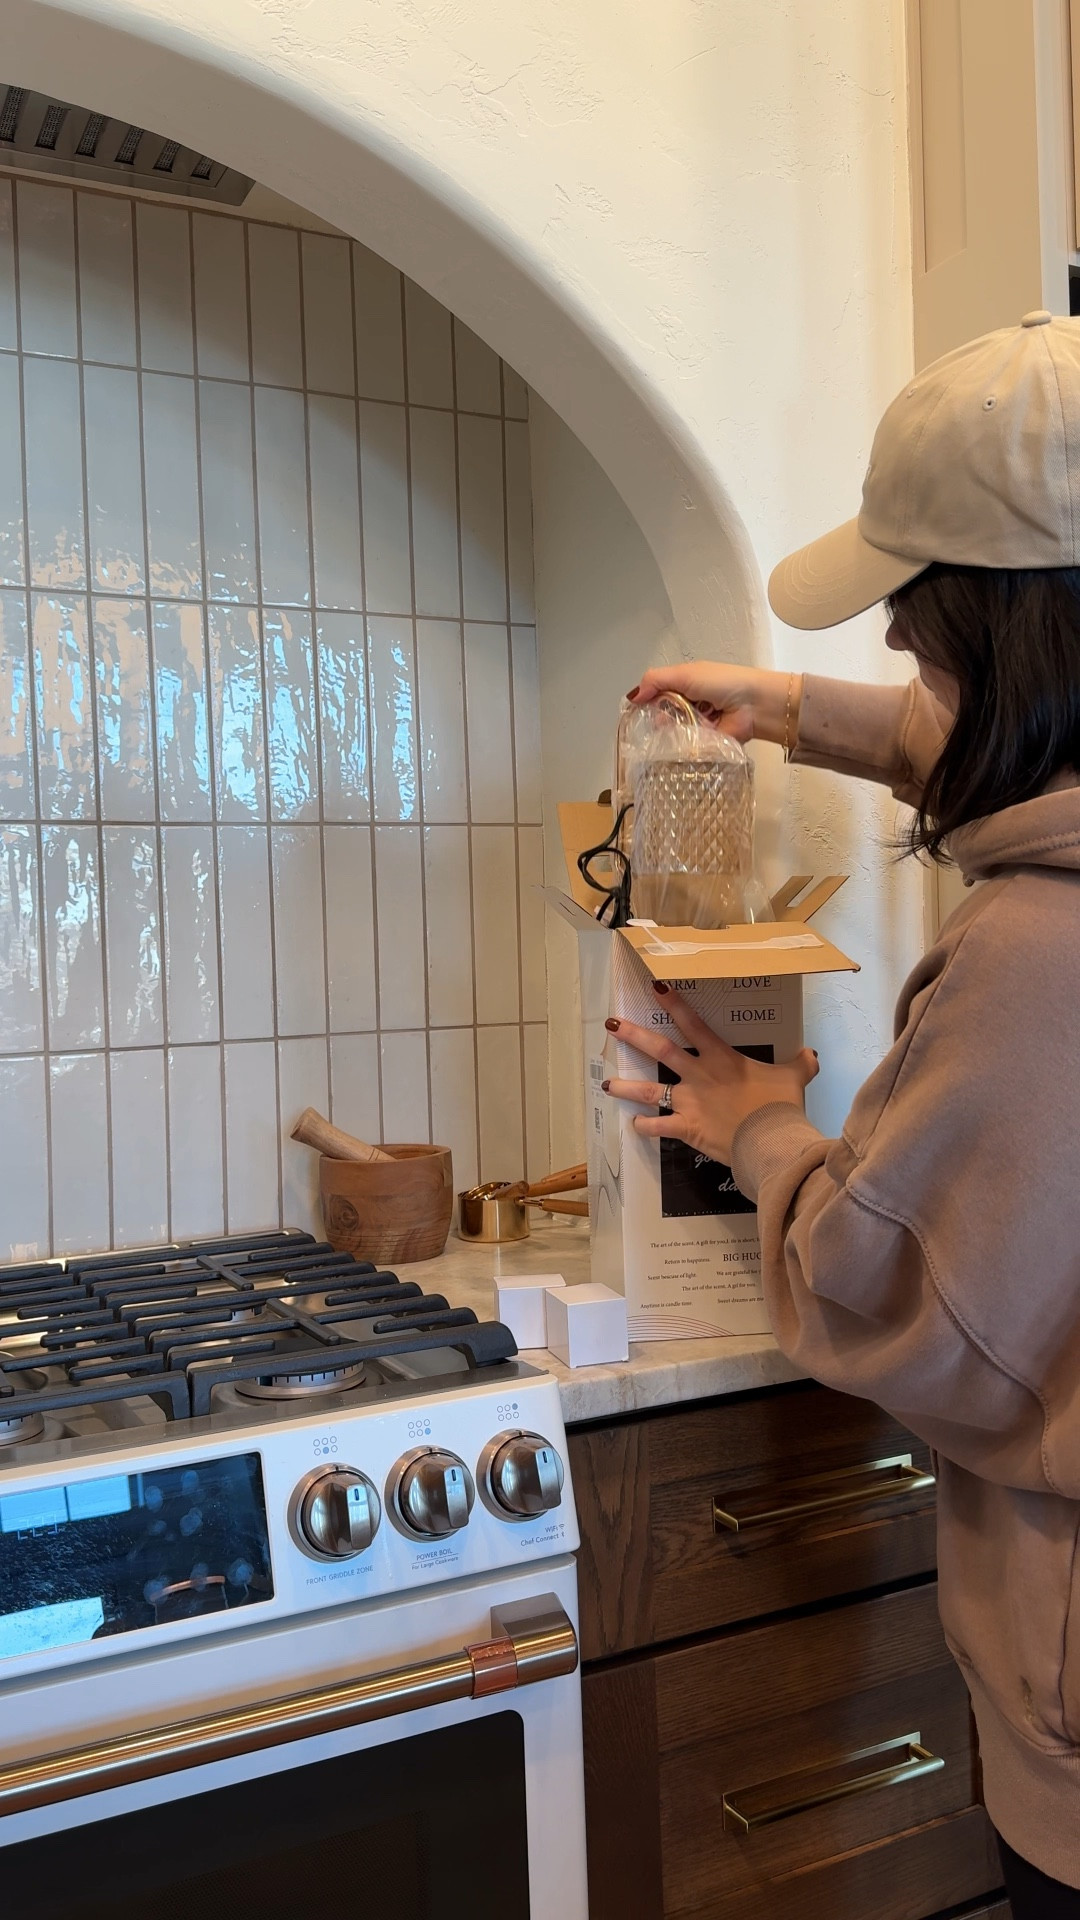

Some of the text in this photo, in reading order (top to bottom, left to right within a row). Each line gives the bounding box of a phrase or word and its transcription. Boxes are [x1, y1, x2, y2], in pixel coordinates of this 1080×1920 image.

[651, 979, 697, 990] RM
[733, 976, 771, 989] LOVE
[730, 1009, 776, 1022] HOME
[723, 1252, 739, 1262] BIG
[520, 1533, 559, 1547] Chef Connect
[416, 1548, 453, 1561] POWER BOIL
[420, 1561, 434, 1570] Large
[306, 1564, 374, 1586] FRONT GRIDDLE ZONE
